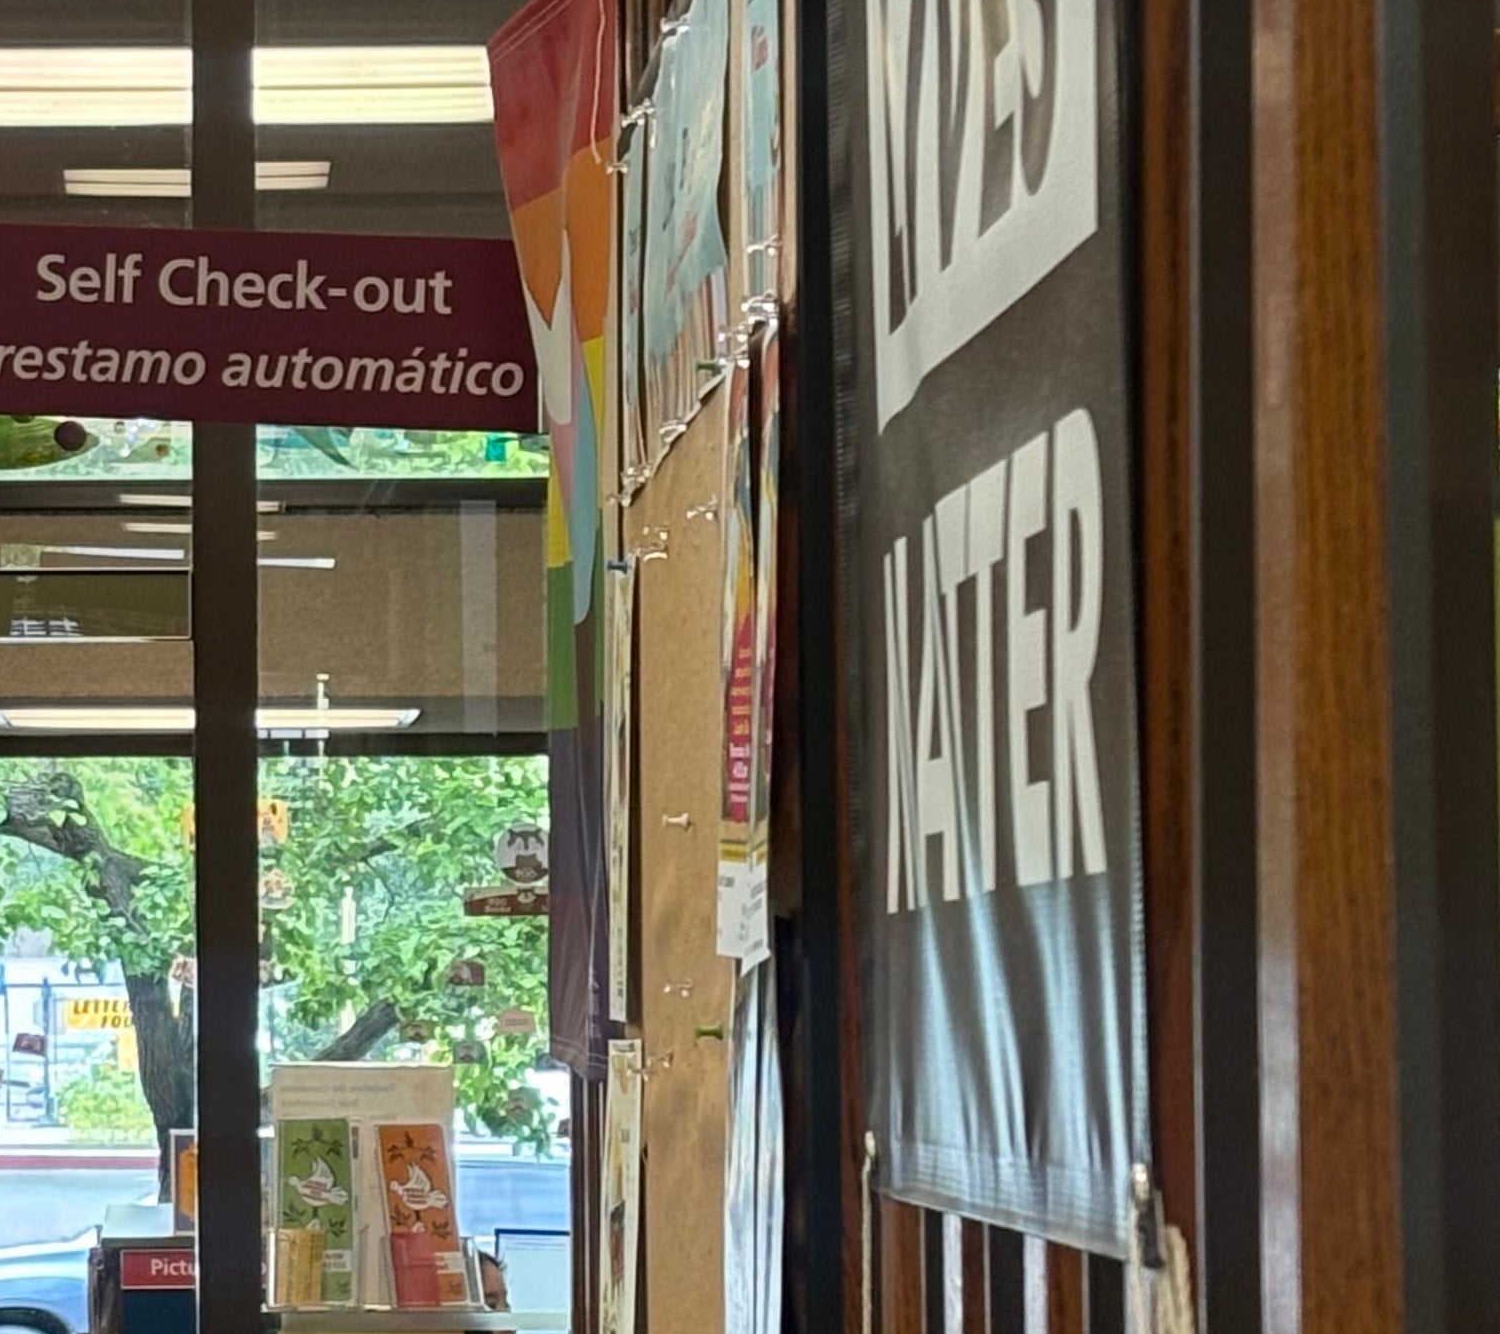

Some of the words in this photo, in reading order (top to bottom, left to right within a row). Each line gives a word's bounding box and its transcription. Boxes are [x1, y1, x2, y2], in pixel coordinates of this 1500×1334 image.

[35, 253, 143, 303] Self
[158, 257, 453, 315] Check-out
[221, 346, 525, 397] automático
